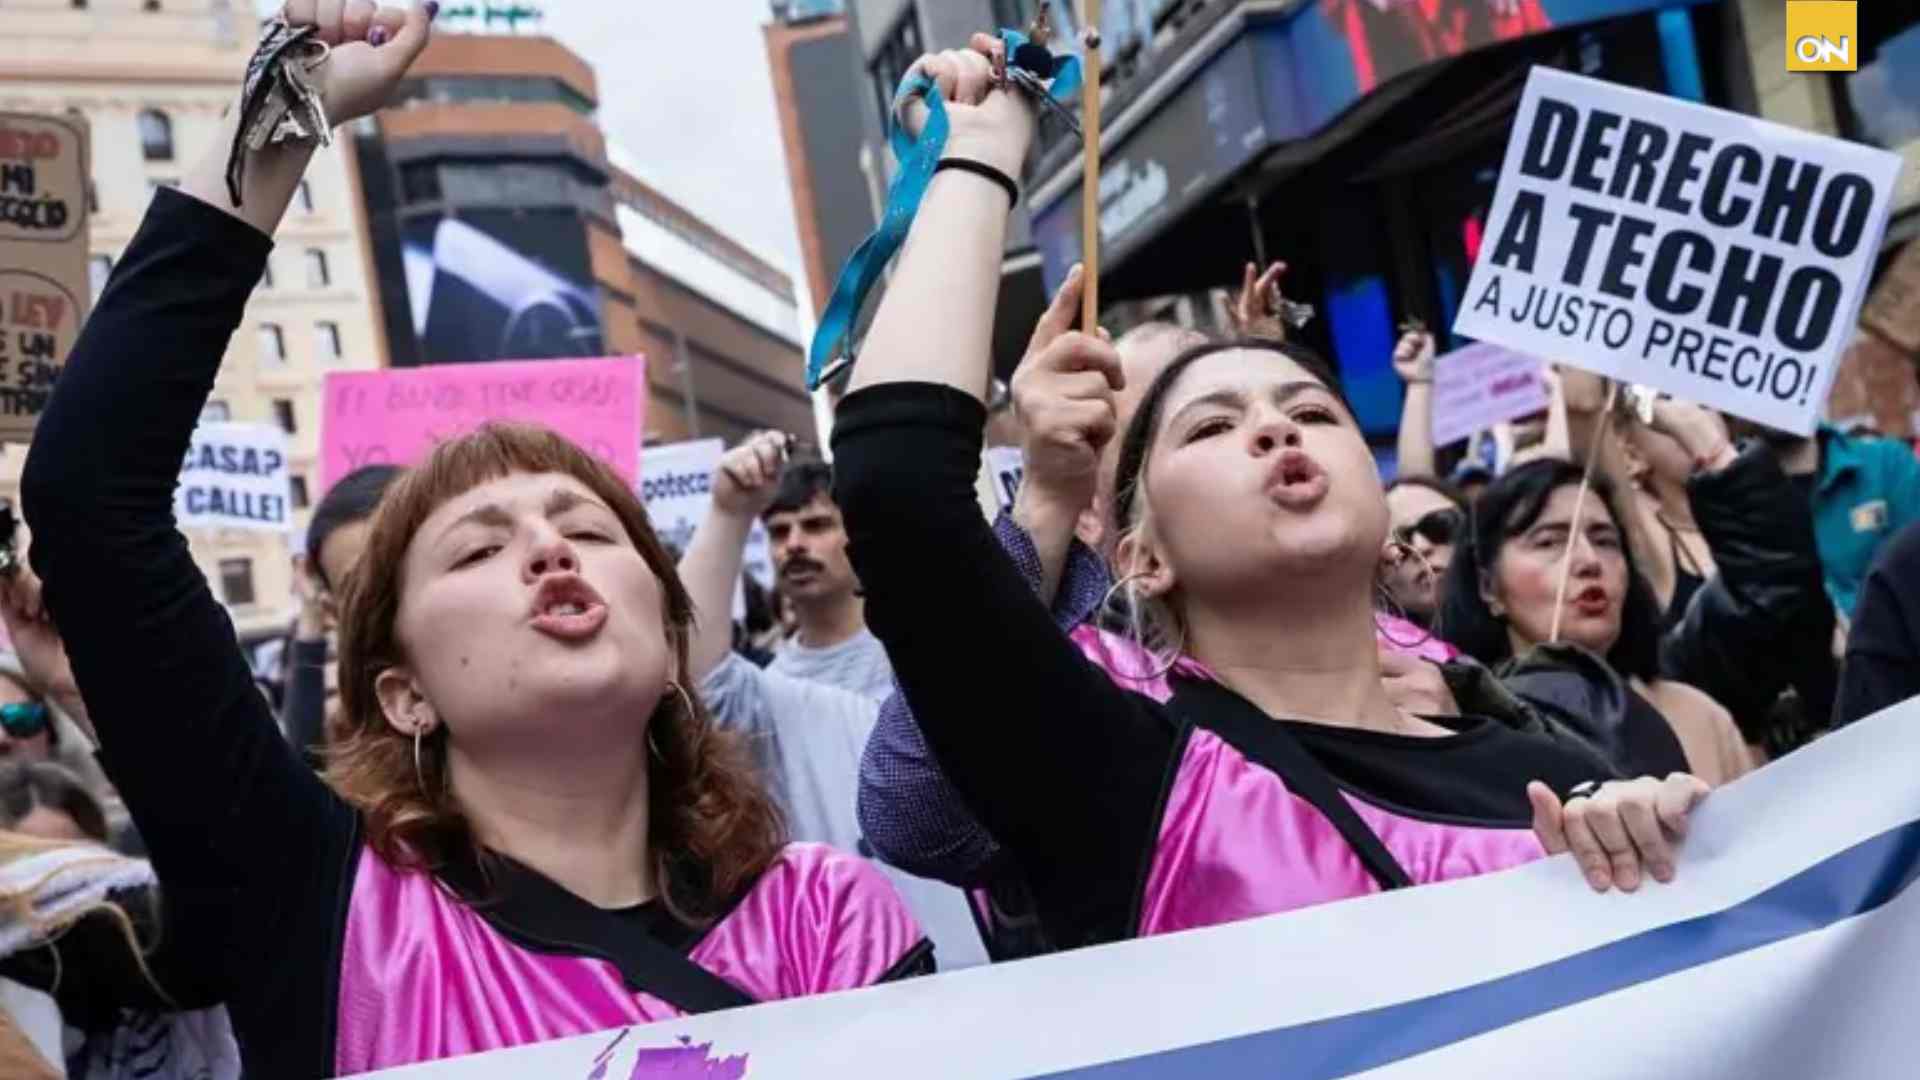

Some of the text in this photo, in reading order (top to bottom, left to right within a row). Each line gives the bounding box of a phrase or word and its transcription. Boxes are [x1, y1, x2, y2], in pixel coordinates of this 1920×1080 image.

[1519, 97, 1875, 258] DERECHO
[1474, 275, 1817, 406] A JUSTO PRECIO!
[1490, 189, 1843, 353] A TECHO
[185, 486, 284, 523] CALLE!
